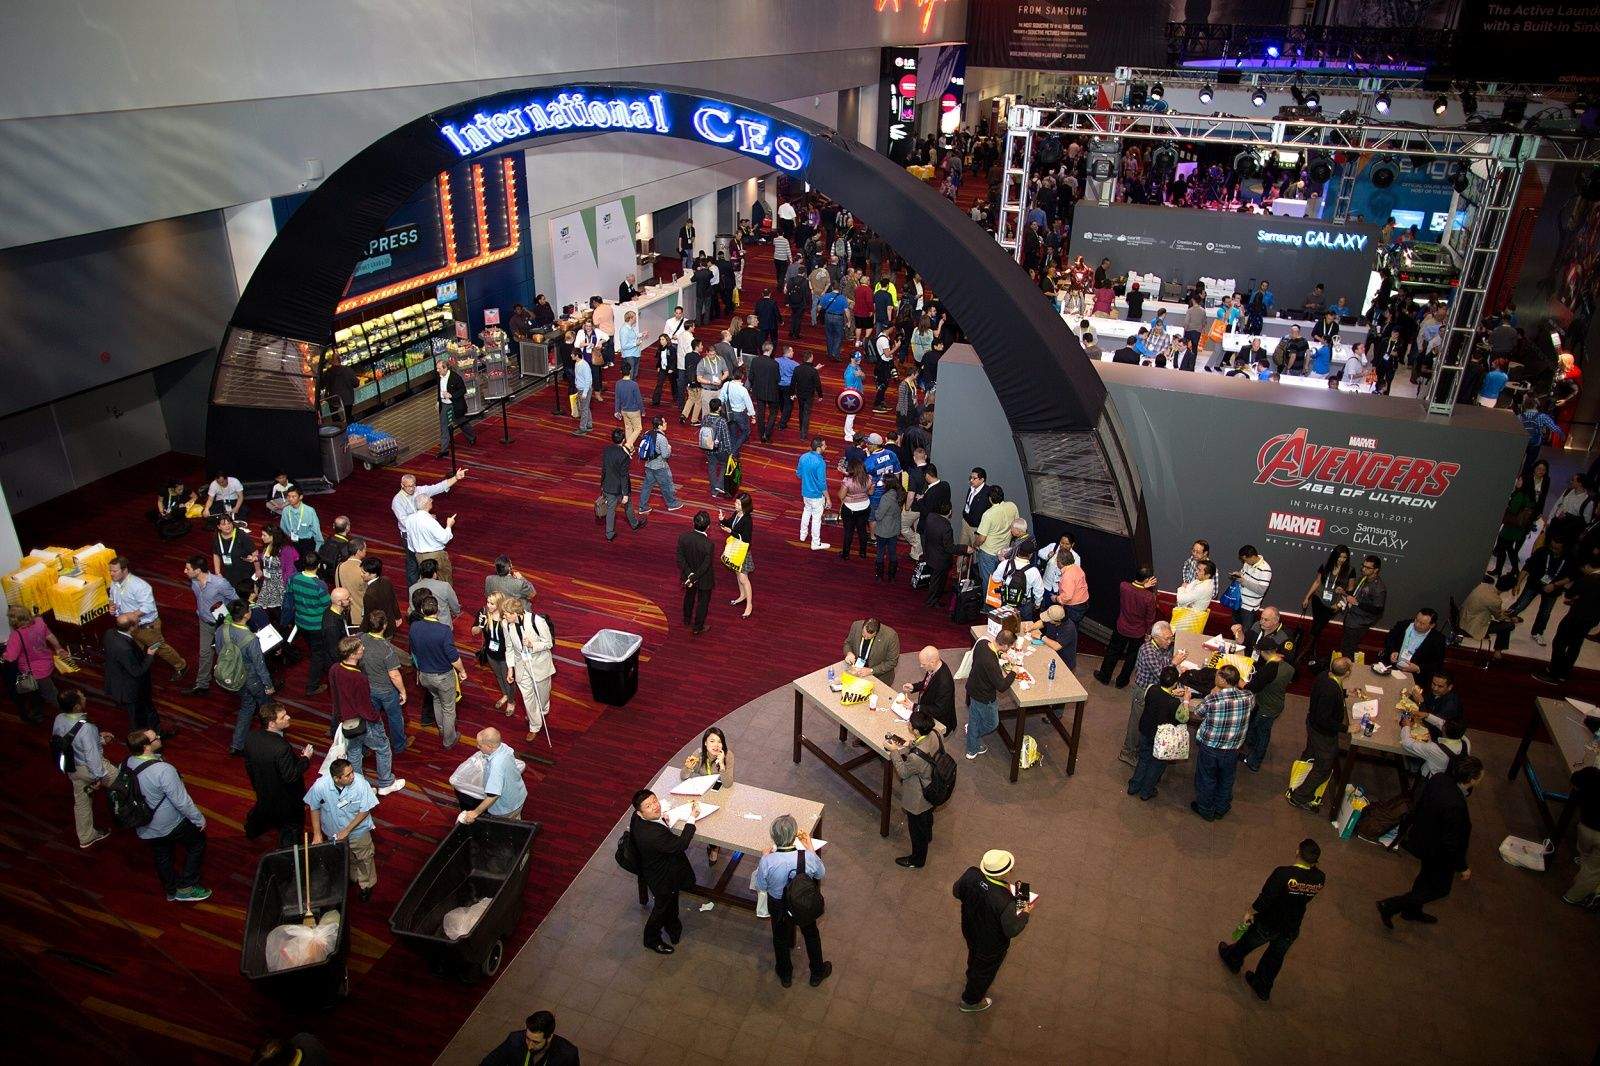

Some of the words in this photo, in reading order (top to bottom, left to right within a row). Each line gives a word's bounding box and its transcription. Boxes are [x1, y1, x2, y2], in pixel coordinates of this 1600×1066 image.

[1018, 5, 1041, 14] FROM
[1045, 6, 1087, 15] SAMSUNG
[1487, 4, 1511, 16] The
[1513, 4, 1554, 16] Active
[1483, 20, 1510, 31] with
[1512, 24, 1520, 32] a
[1523, 21, 1569, 32] Built-in
[442, 93, 668, 155] International
[693, 107, 802, 171] CES
[364, 229, 418, 255] PRESS
[1257, 229, 1303, 247] Samsung
[1304, 230, 1368, 251] GALAXY
[1349, 436, 1377, 449] MARVEL
[1253, 428, 1460, 497] AVENGERS
[1299, 483, 1334, 495] AGE
[1340, 488, 1365, 499] OF
[1369, 492, 1437, 510] ULTRON
[1290, 499, 1301, 507] IN
[1305, 501, 1354, 515] THEATERS
[1358, 509, 1413, 524] 05.01.2015
[1268, 512, 1322, 537] MARVEL
[1356, 523, 1398, 538] Samsung
[1353, 532, 1409, 550] GALAXY
[80, 604, 109, 625] Nikon
